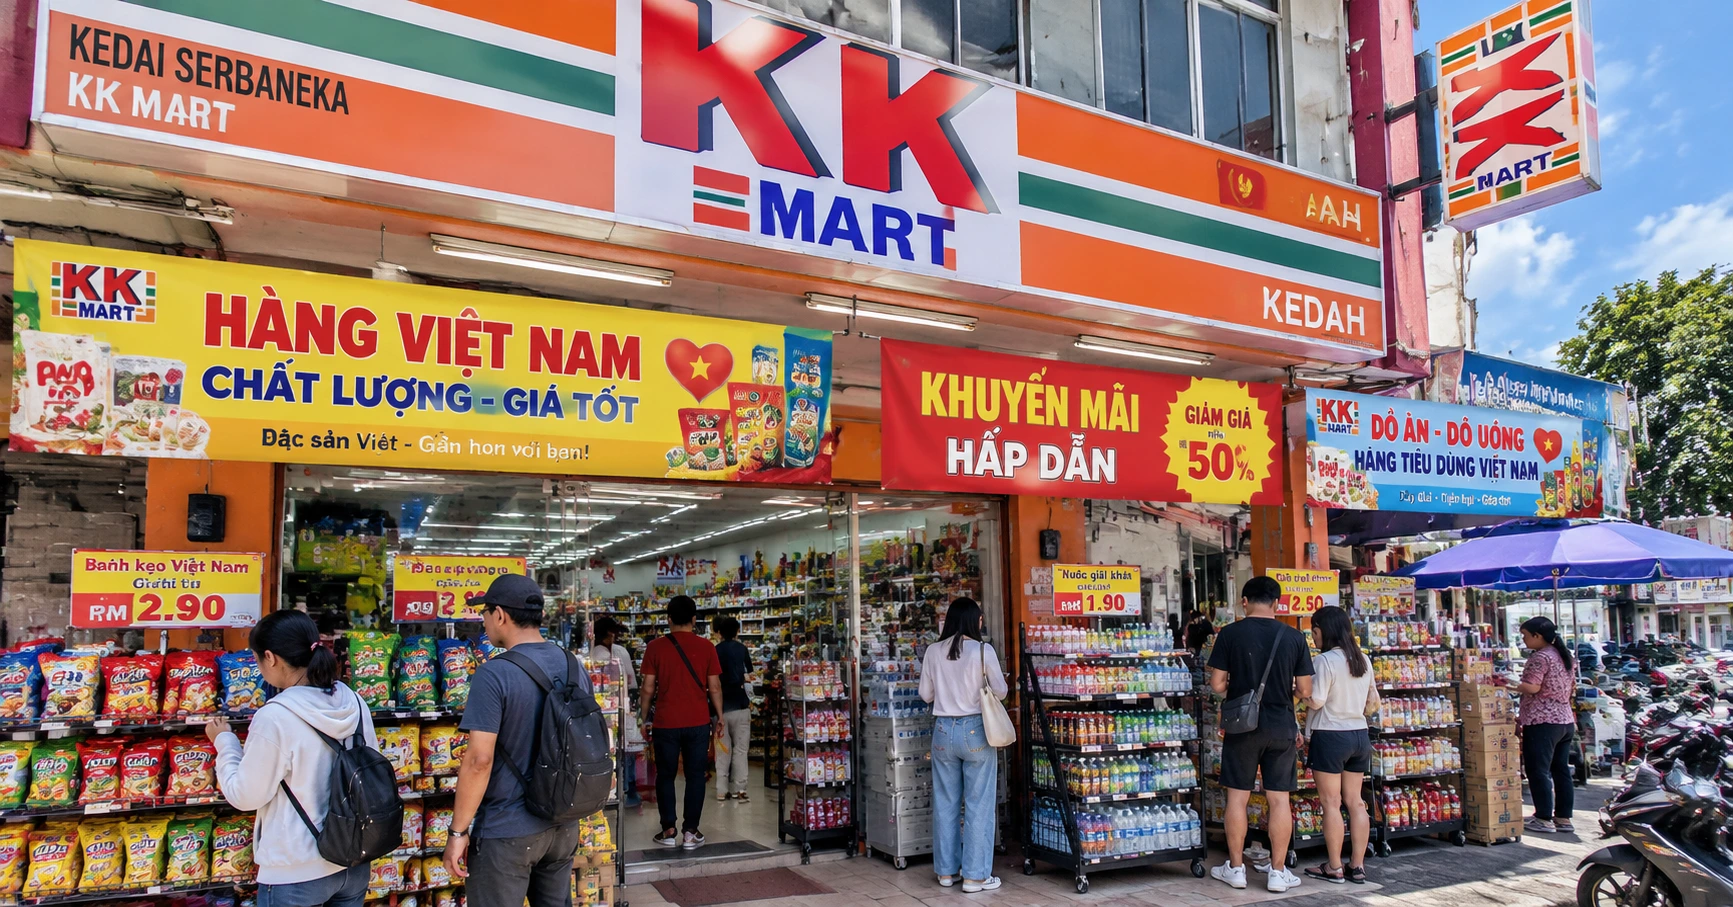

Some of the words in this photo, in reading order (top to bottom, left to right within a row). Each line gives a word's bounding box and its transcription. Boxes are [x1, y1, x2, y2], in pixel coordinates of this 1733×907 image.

[70, 23, 164, 78] KEDAI
[175, 47, 349, 115] SERBANEKA
[68, 71, 121, 115] KK
[131, 85, 236, 133] MART
[641, 0, 1001, 214] KK
[760, 180, 955, 266] MART
[63, 263, 142, 305] KK
[79, 302, 135, 321] MART
[204, 285, 378, 358] HÀNG
[395, 307, 513, 378] VIỆT
[530, 326, 640, 381] NAM
[1262, 286, 1365, 336] KEDAH
[202, 358, 319, 404] CHẤT
[333, 374, 472, 418] LƯỢNG
[502, 380, 564, 419] GIÁ
[572, 384, 639, 423] TỐT
[921, 366, 1069, 428] KHUYẾN
[1080, 382, 1140, 433] MÃI
[1321, 398, 1354, 424] KK
[311, 430, 349, 450] sản
[946, 425, 1028, 479] HẤP
[1038, 431, 1118, 484] DẪN
[210, 560, 249, 573] Nam
[89, 604, 127, 622] RM
[137, 593, 226, 622] 2.90
[1086, 594, 1126, 612] 1.90
[1291, 595, 1324, 612] 2.50
